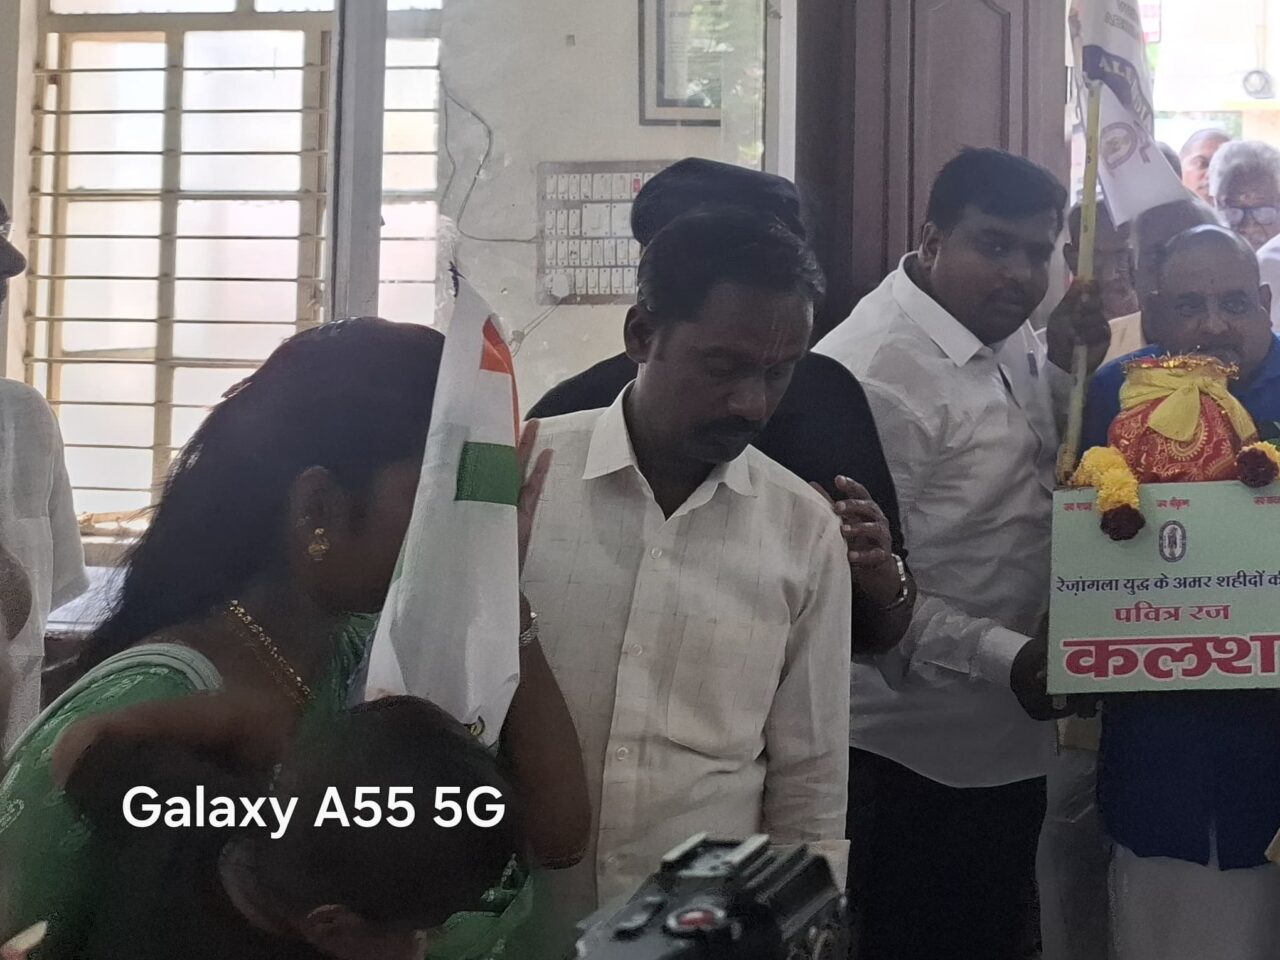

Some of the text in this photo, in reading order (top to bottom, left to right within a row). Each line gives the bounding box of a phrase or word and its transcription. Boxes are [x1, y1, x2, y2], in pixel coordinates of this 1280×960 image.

[1056, 576, 1119, 596] रेज़ांगला
[1123, 578, 1150, 596] युद्ध
[1153, 572, 1169, 590] के
[1172, 575, 1212, 589] अमर
[1215, 569, 1265, 589] शहीदों
[1113, 600, 1231, 623] पवित्र रज
